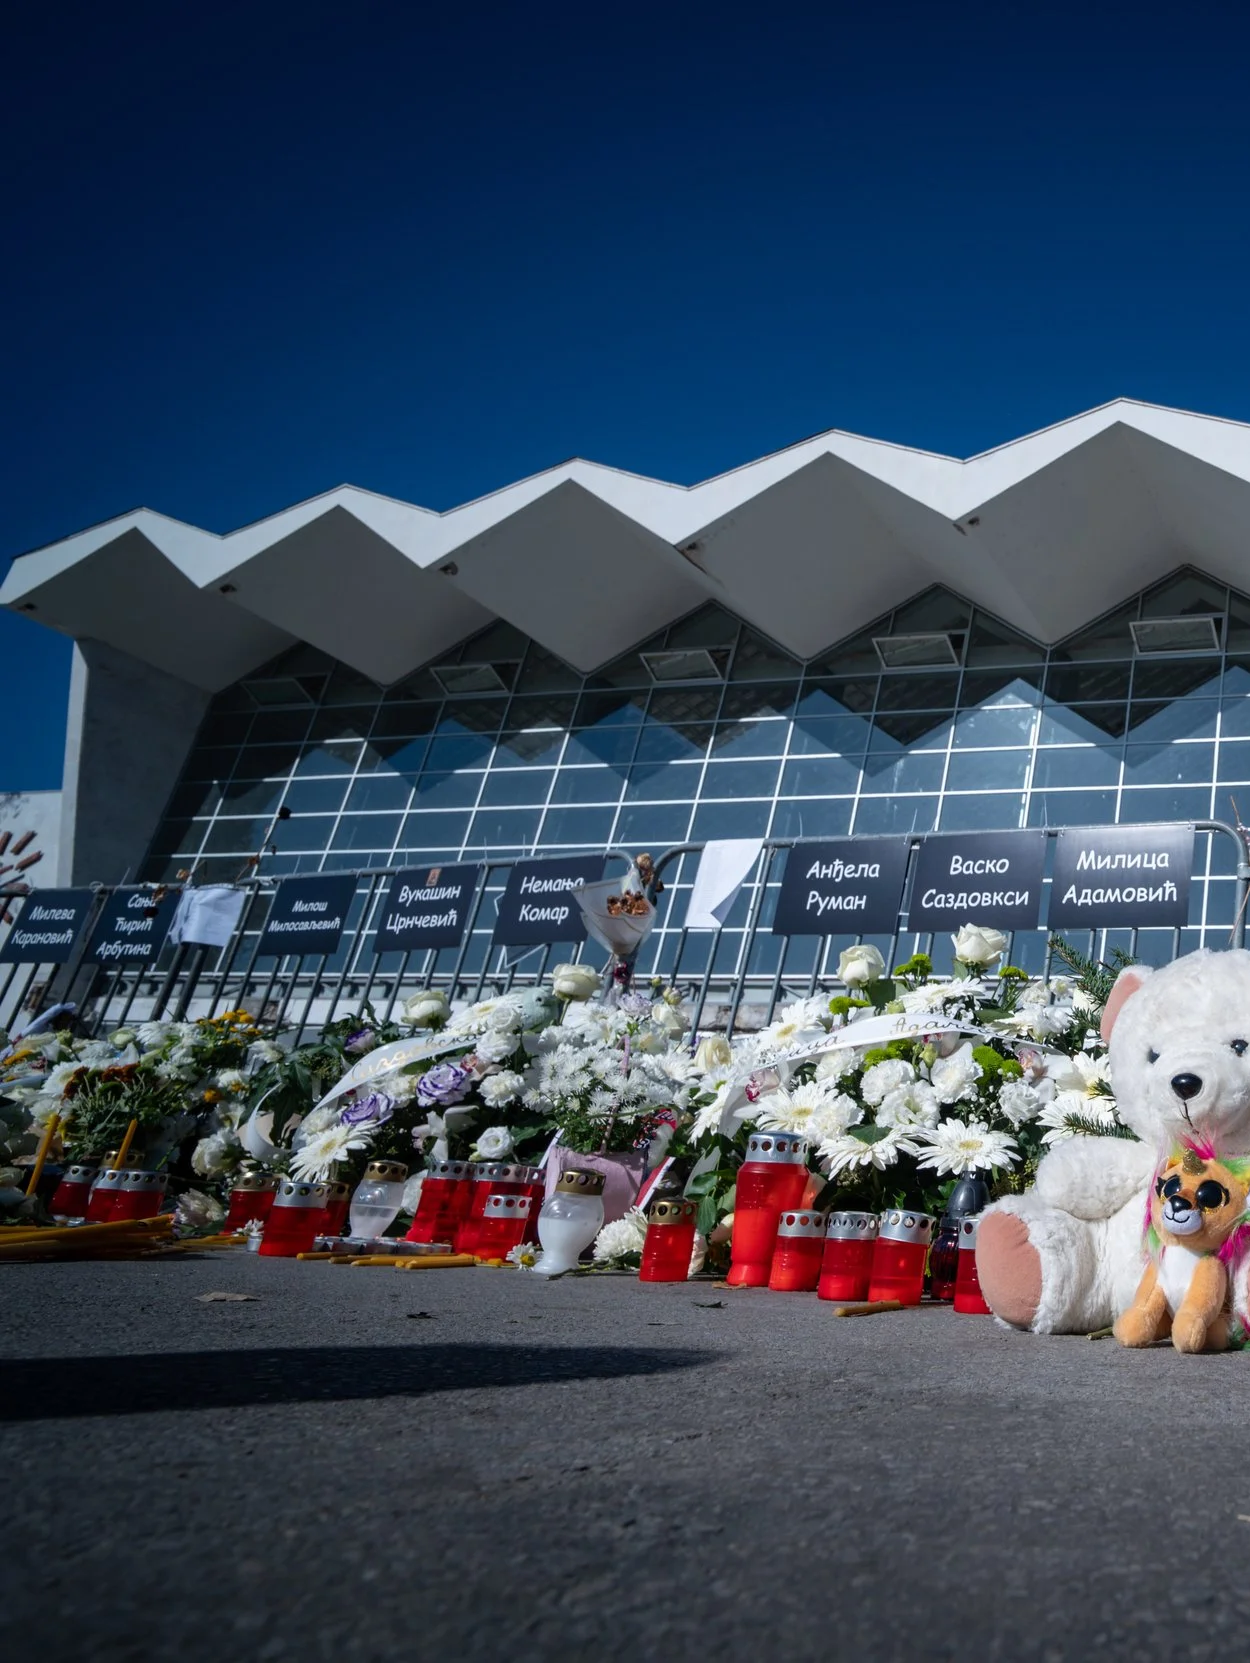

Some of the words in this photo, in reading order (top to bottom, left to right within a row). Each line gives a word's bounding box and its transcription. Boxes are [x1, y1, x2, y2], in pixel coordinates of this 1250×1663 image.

[805, 858, 881, 883] Анђела
[949, 854, 1010, 876] Васко
[1076, 849, 1170, 871] Милица
[398, 884, 462, 908] Вукашин
[805, 890, 867, 916] Руман
[921, 888, 1030, 910] Саздовкси
[1062, 880, 1178, 907] Адамовић
[28, 905, 76, 921] Милева
[291, 899, 329, 913] Милош
[518, 903, 570, 926] Комар
[114, 916, 154, 936] Ћирић
[267, 916, 341, 933] Милосављевић
[385, 908, 458, 935] Црнчевић
[10, 928, 74, 949] Карановић
[95, 940, 153, 960] Арбутина
